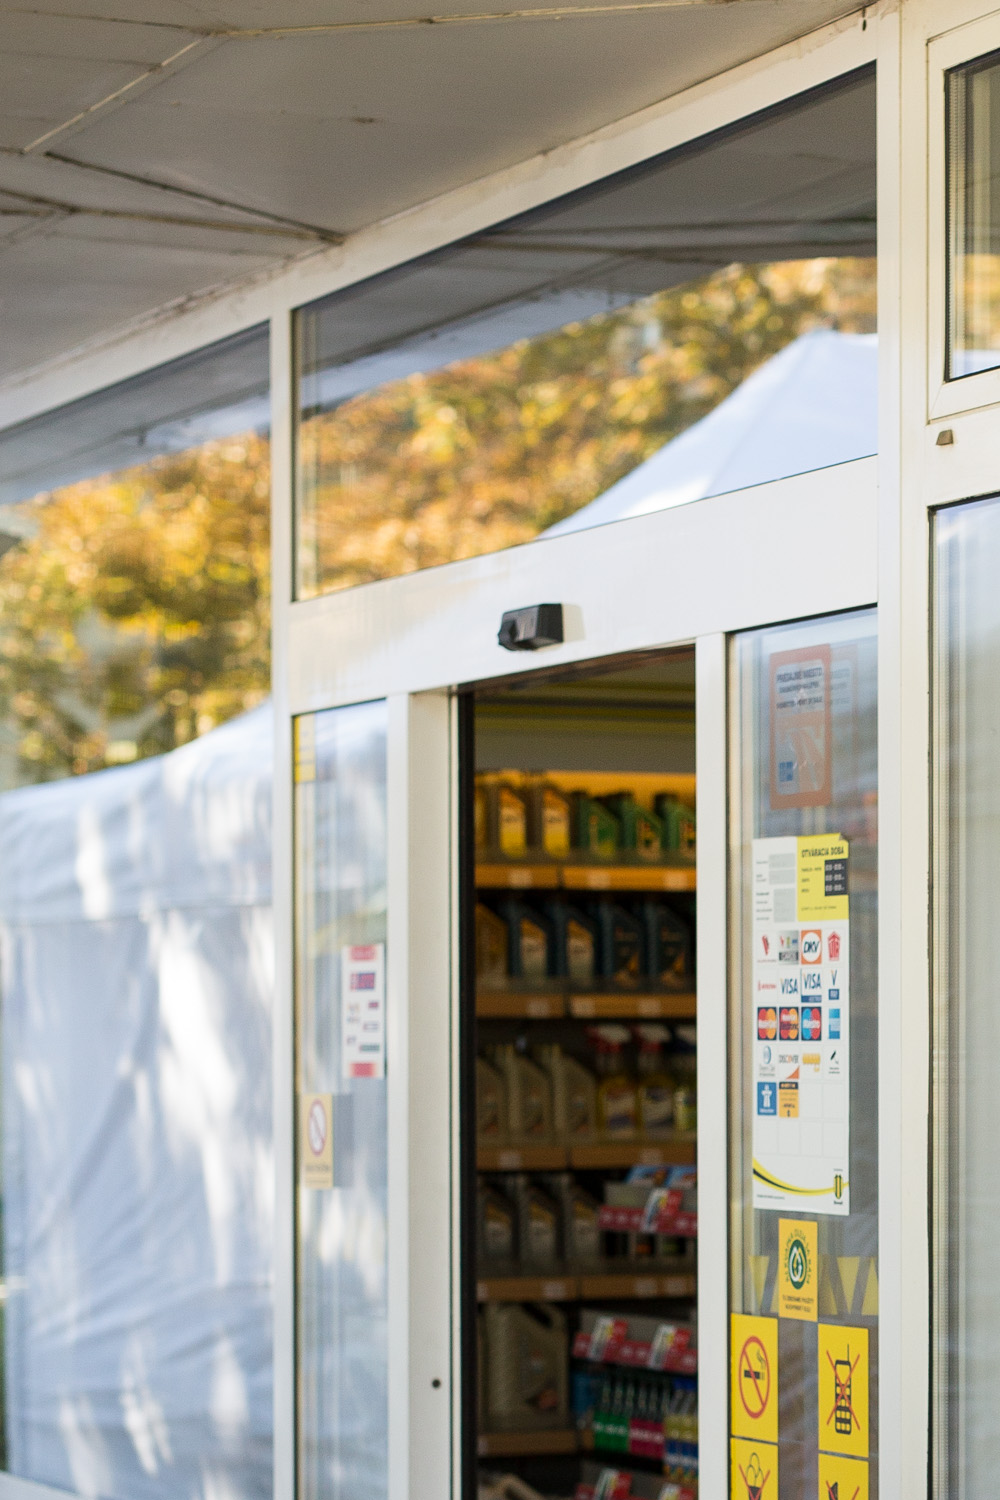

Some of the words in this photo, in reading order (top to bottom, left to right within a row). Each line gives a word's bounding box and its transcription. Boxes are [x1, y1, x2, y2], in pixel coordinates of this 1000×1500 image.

[803, 940, 820, 953] DKV
[781, 978, 798, 994] VISA
[802, 972, 821, 989] VISA
